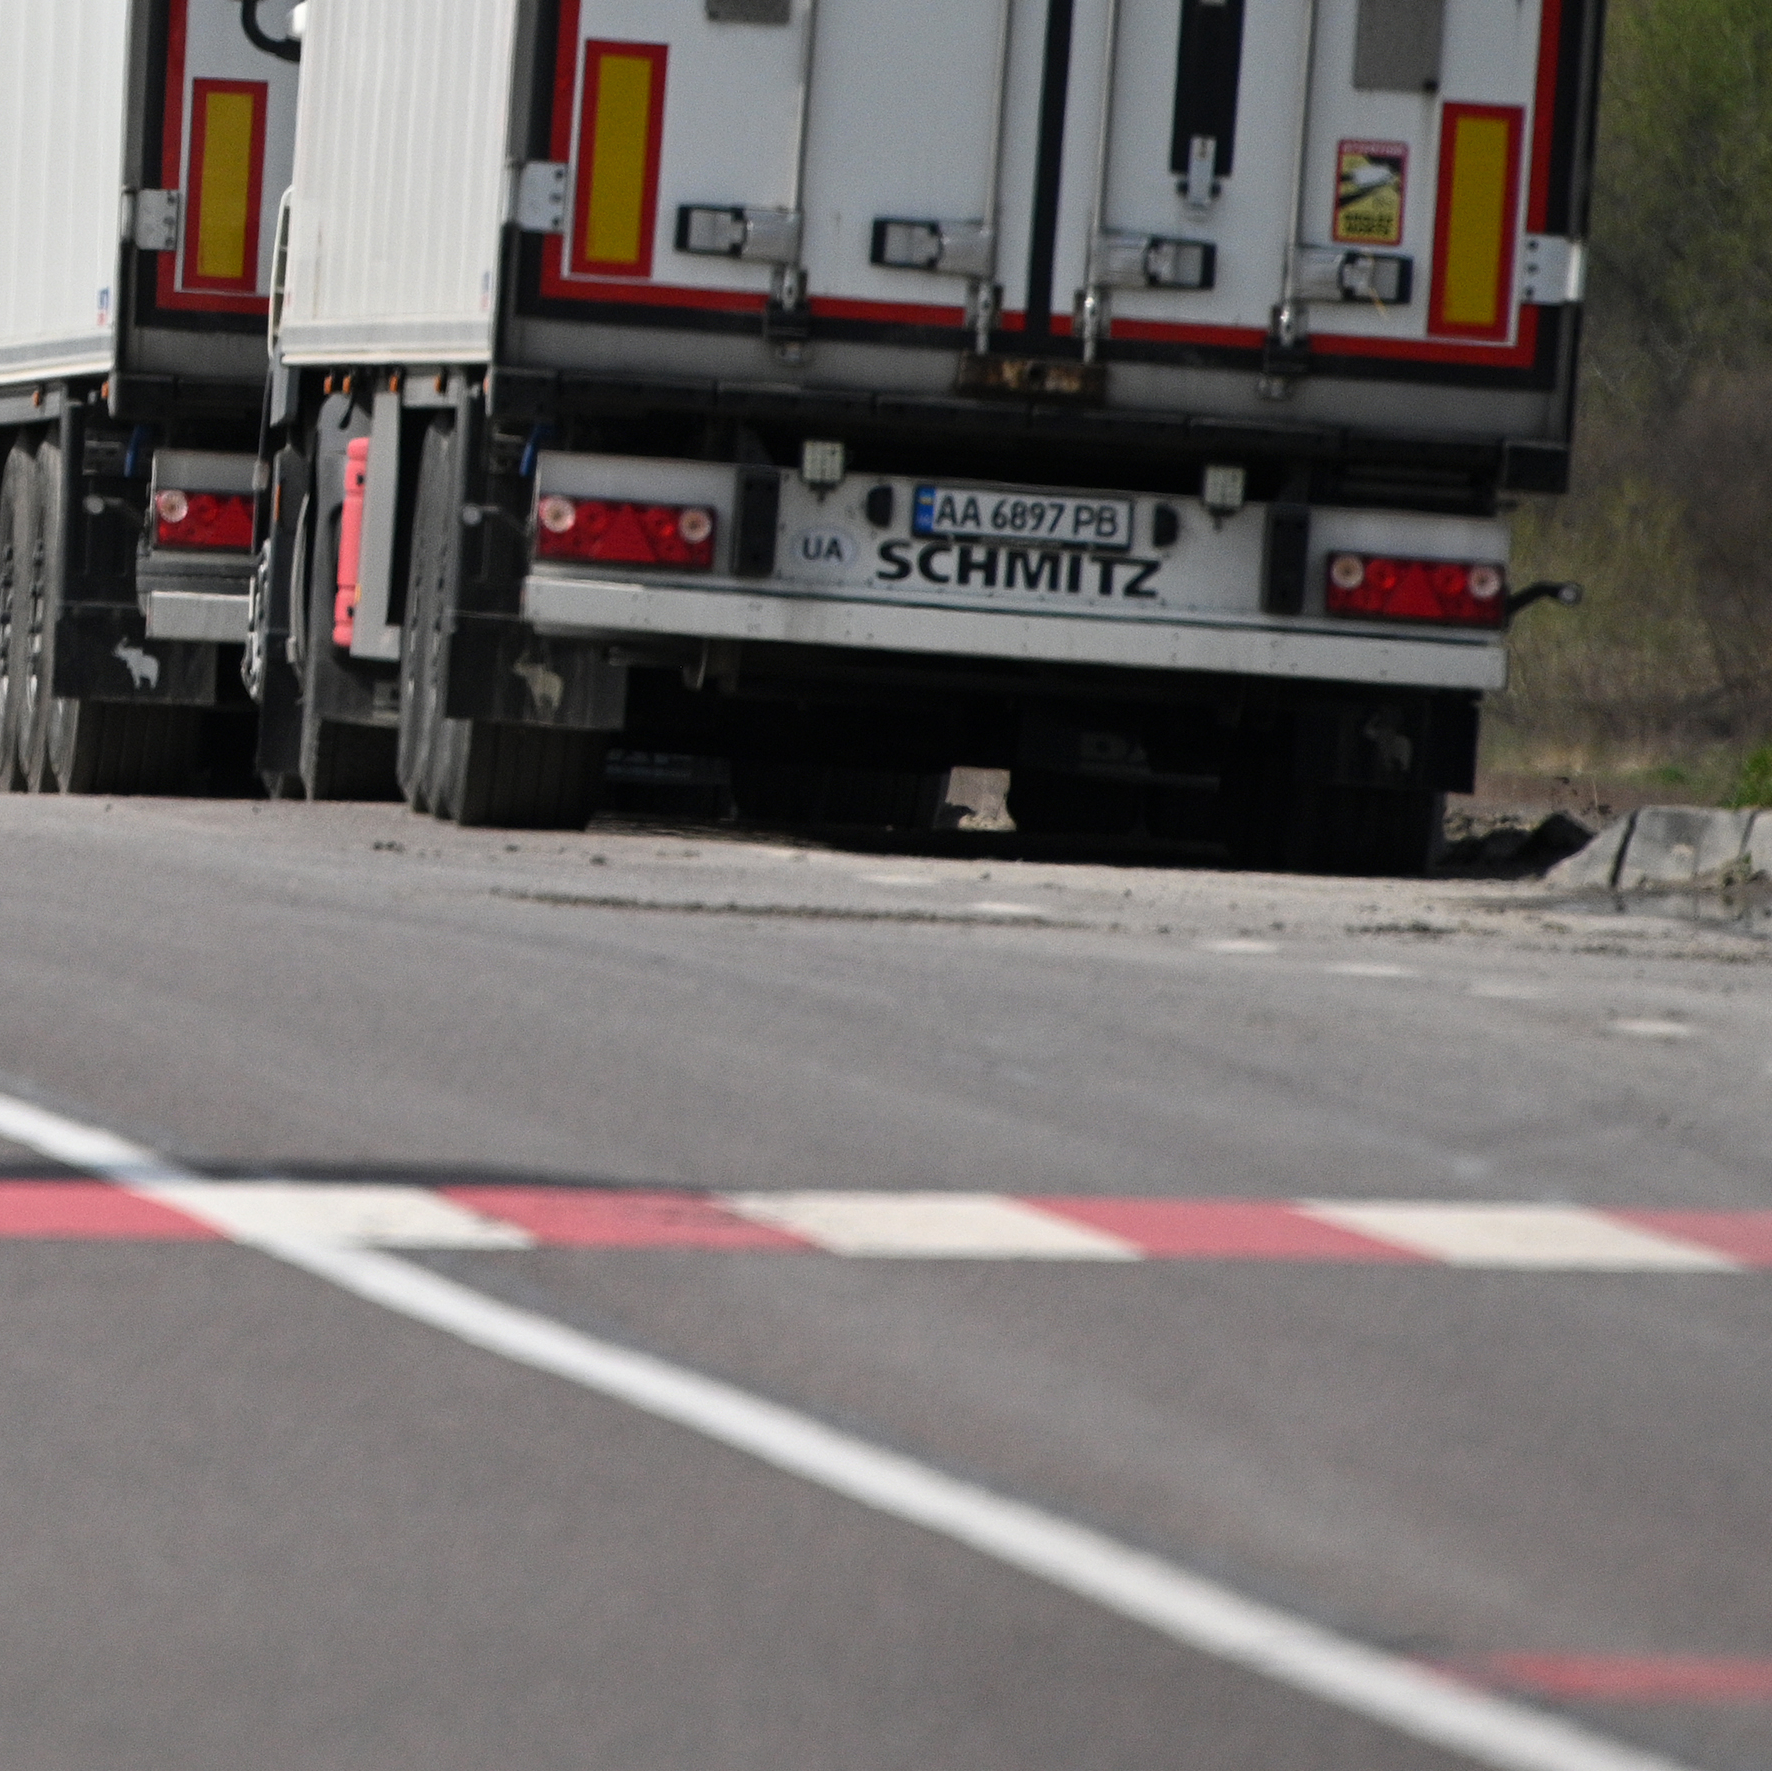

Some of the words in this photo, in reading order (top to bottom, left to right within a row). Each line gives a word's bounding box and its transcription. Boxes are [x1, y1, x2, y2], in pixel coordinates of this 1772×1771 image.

[936, 494, 982, 528] AA
[990, 498, 1066, 534] 6897
[1071, 503, 1118, 537] PB
[801, 537, 844, 562] UA
[875, 537, 1162, 598] SCHMITZ
